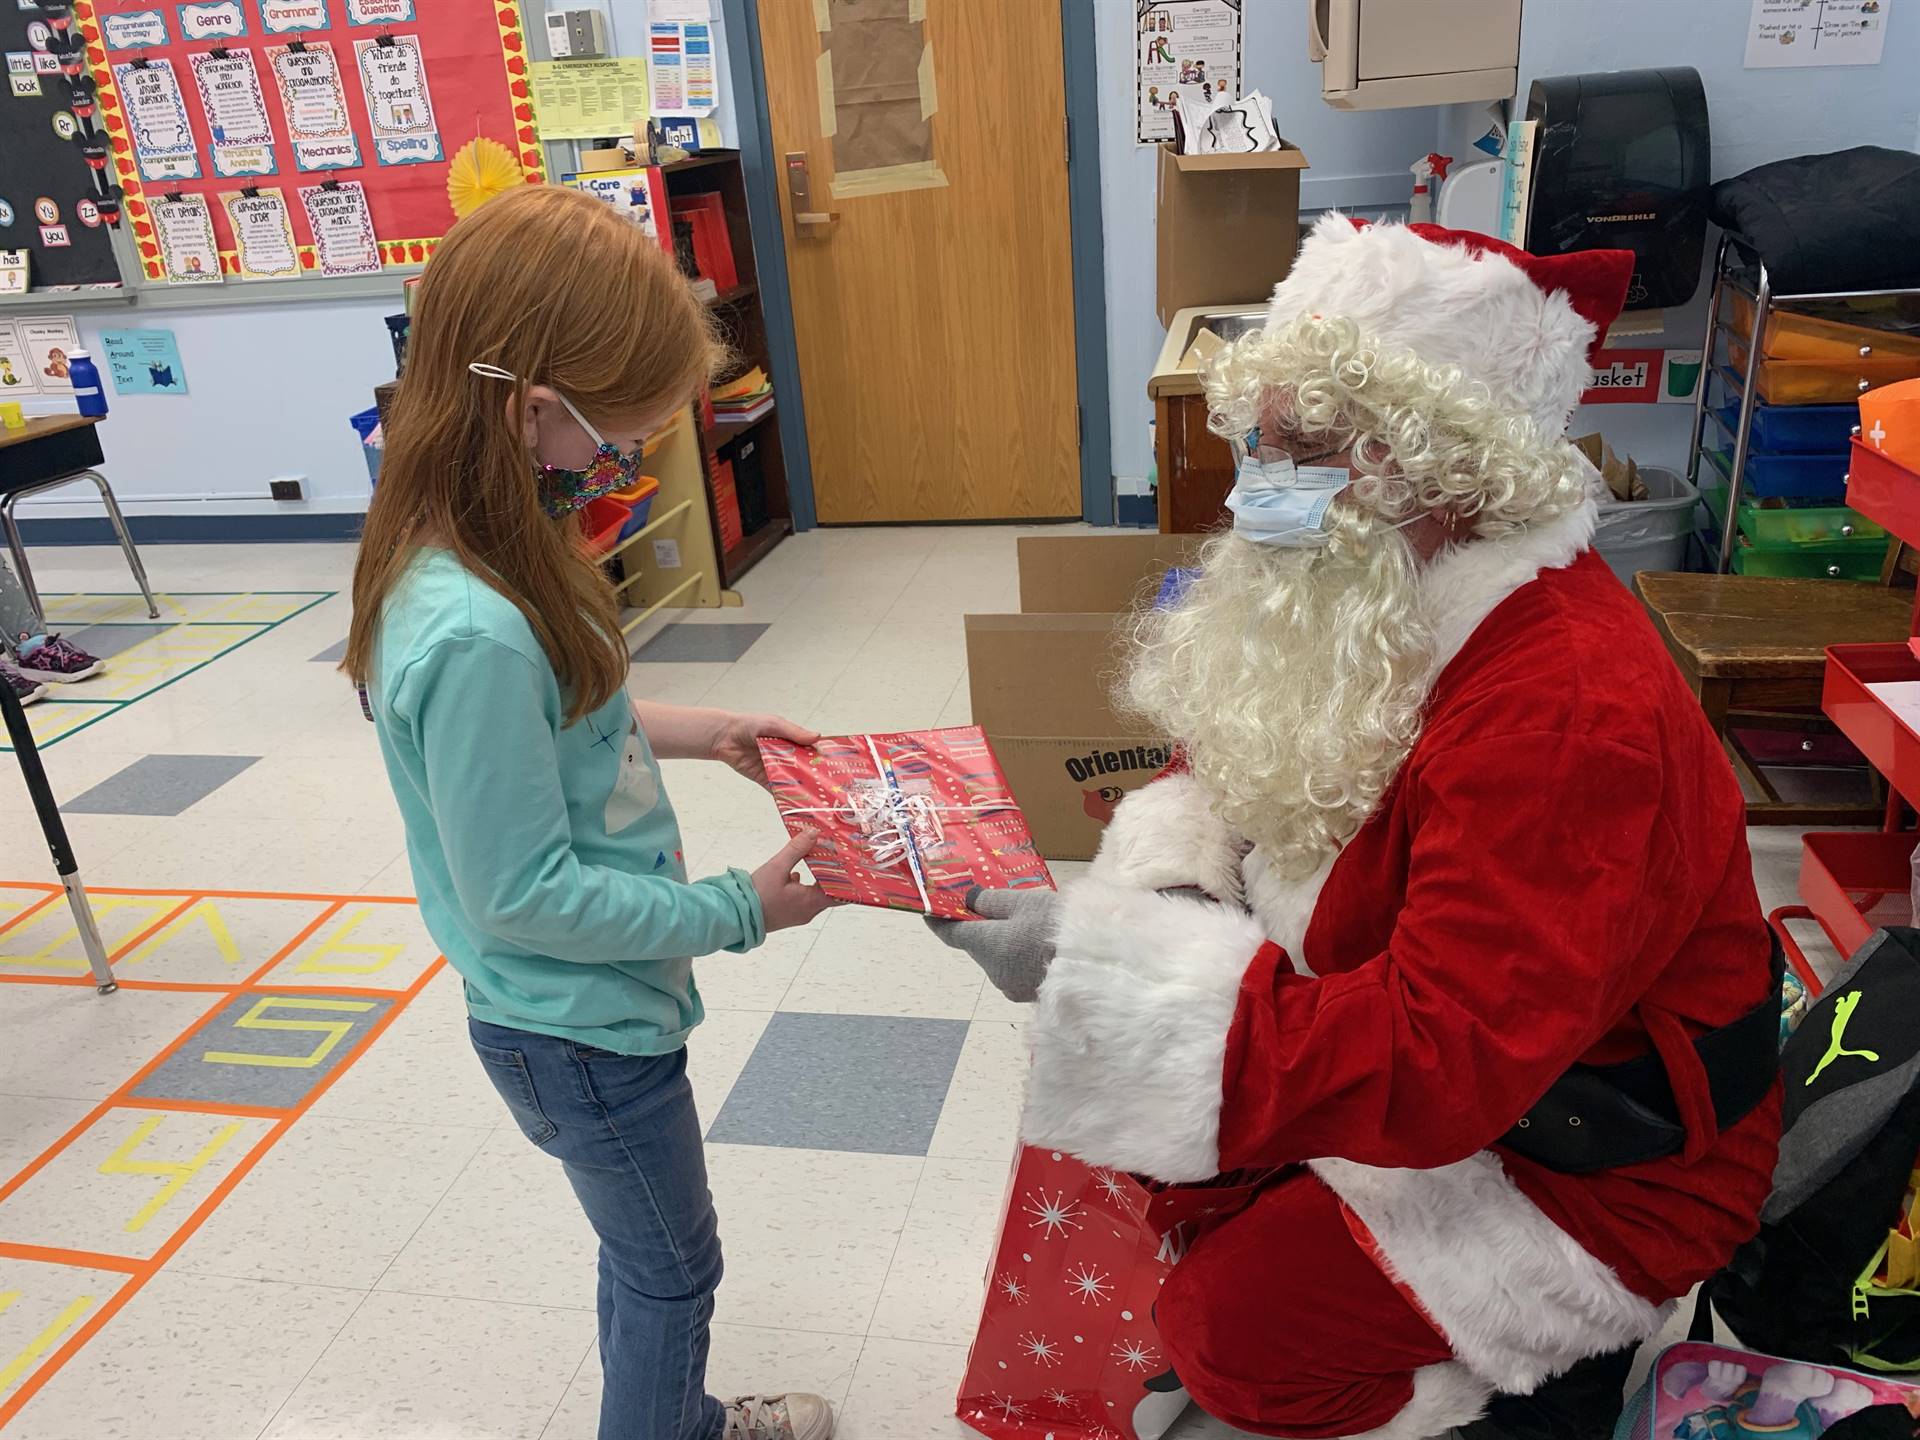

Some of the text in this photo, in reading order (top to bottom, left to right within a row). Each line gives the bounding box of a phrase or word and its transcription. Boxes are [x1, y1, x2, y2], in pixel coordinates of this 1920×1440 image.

[269, 7, 319, 19] Grammar
[360, 4, 402, 15] Question
[109, 20, 159, 31] Comprehension
[196, 14, 232, 26] Genre
[122, 29, 151, 38] Strategy
[371, 48, 407, 61] What do
[10, 58, 31, 70] little
[40, 57, 57, 69] like
[377, 62, 407, 73] friends
[562, 62, 593, 70] EMERGENCY
[16, 80, 37, 92] look
[390, 75, 400, 86] do
[378, 87, 417, 105] together?
[58, 119, 70, 131] Rr
[667, 129, 692, 149] light
[387, 138, 429, 153] Spelling
[223, 148, 262, 158] Structural
[302, 145, 351, 158] Mechanics
[144, 154, 191, 164] Comprehension
[230, 159, 260, 168] Analysis
[40, 206, 54, 219] Yy
[82, 207, 96, 218] Zz
[1586, 213, 1656, 223] VONDREHLE
[45, 231, 64, 243] you
[3, 256, 20, 264] has
[105, 337, 123, 345] Read
[110, 350, 134, 358] Around
[113, 363, 127, 371] The
[116, 375, 134, 384] Text
[201, 997, 378, 1068] 5
[99, 1115, 247, 1234] 4
